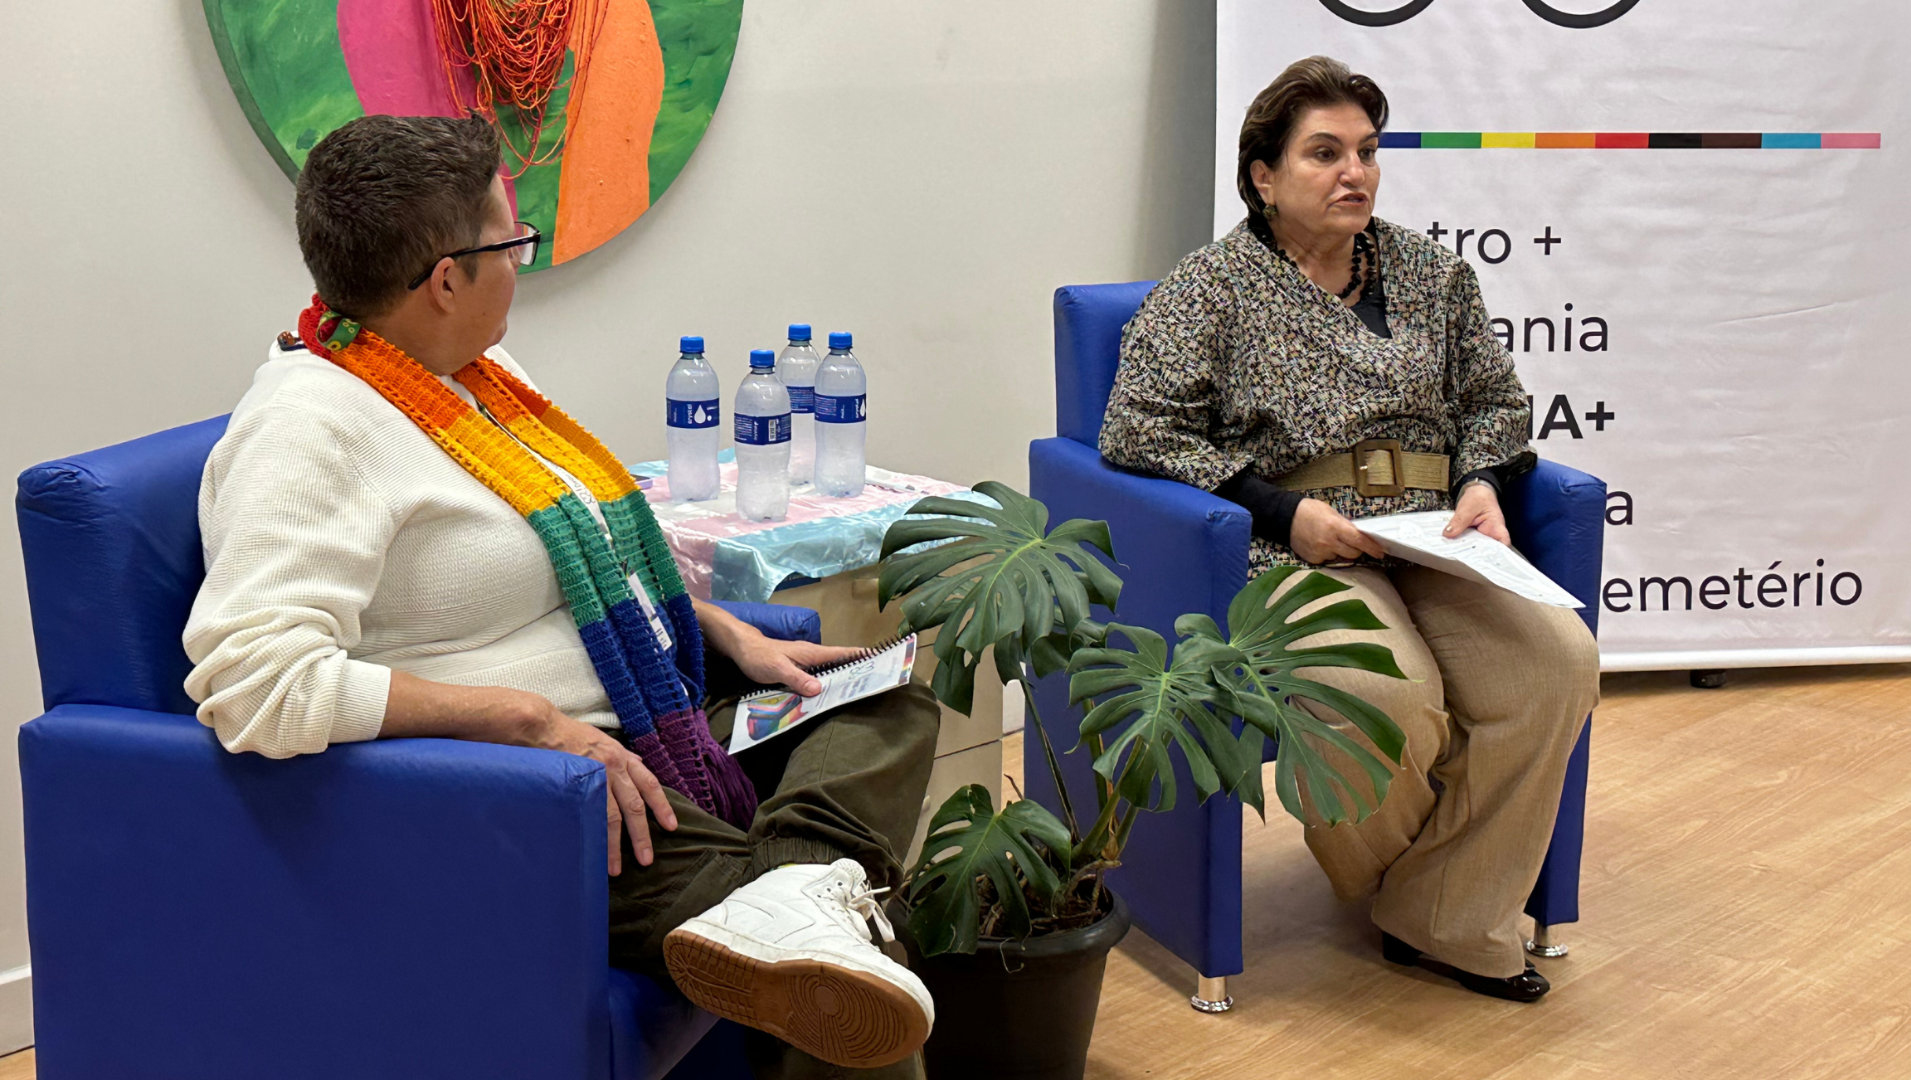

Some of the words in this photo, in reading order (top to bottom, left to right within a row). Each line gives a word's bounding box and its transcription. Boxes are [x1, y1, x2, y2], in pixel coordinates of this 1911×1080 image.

[1533, 226, 1562, 255] +
[1490, 302, 1609, 353] ania
[1605, 490, 1633, 526] a
[1602, 558, 1862, 613] emetério
